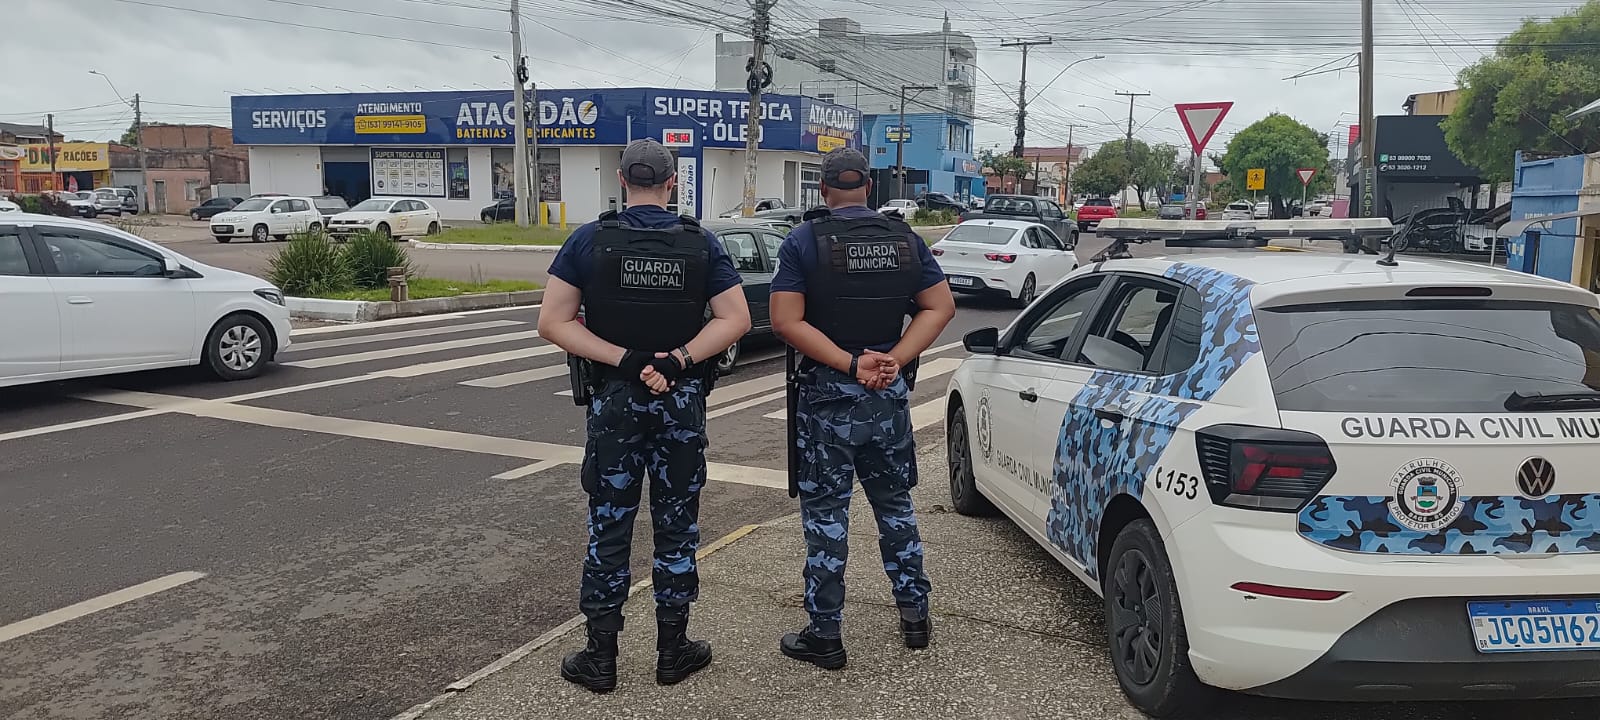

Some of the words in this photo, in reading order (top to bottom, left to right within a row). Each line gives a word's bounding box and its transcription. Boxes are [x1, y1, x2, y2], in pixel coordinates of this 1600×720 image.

[357, 102, 422, 114] ATENDIMENTO
[654, 96, 723, 118] SUPER
[252, 110, 327, 133] SERVIÇOS
[456, 127, 507, 139] BATERIAS
[848, 245, 897, 257] GUARDA
[624, 259, 682, 274] GUARDA
[849, 256, 898, 270] MUNICIPAL
[622, 274, 683, 287] MUNICIPAL
[1341, 417, 1475, 439] GUARDA
[1479, 417, 1554, 439] CIVIL
[1556, 417, 1600, 439] MU
[1393, 459, 1461, 484] PATRULHEIRO
[1166, 469, 1199, 500] 153
[1392, 506, 1430, 529] PROTETOR
[1438, 506, 1460, 527] AMIGO
[1527, 606, 1552, 614] BRASIL
[1487, 616, 1600, 645] JCQ5H62
